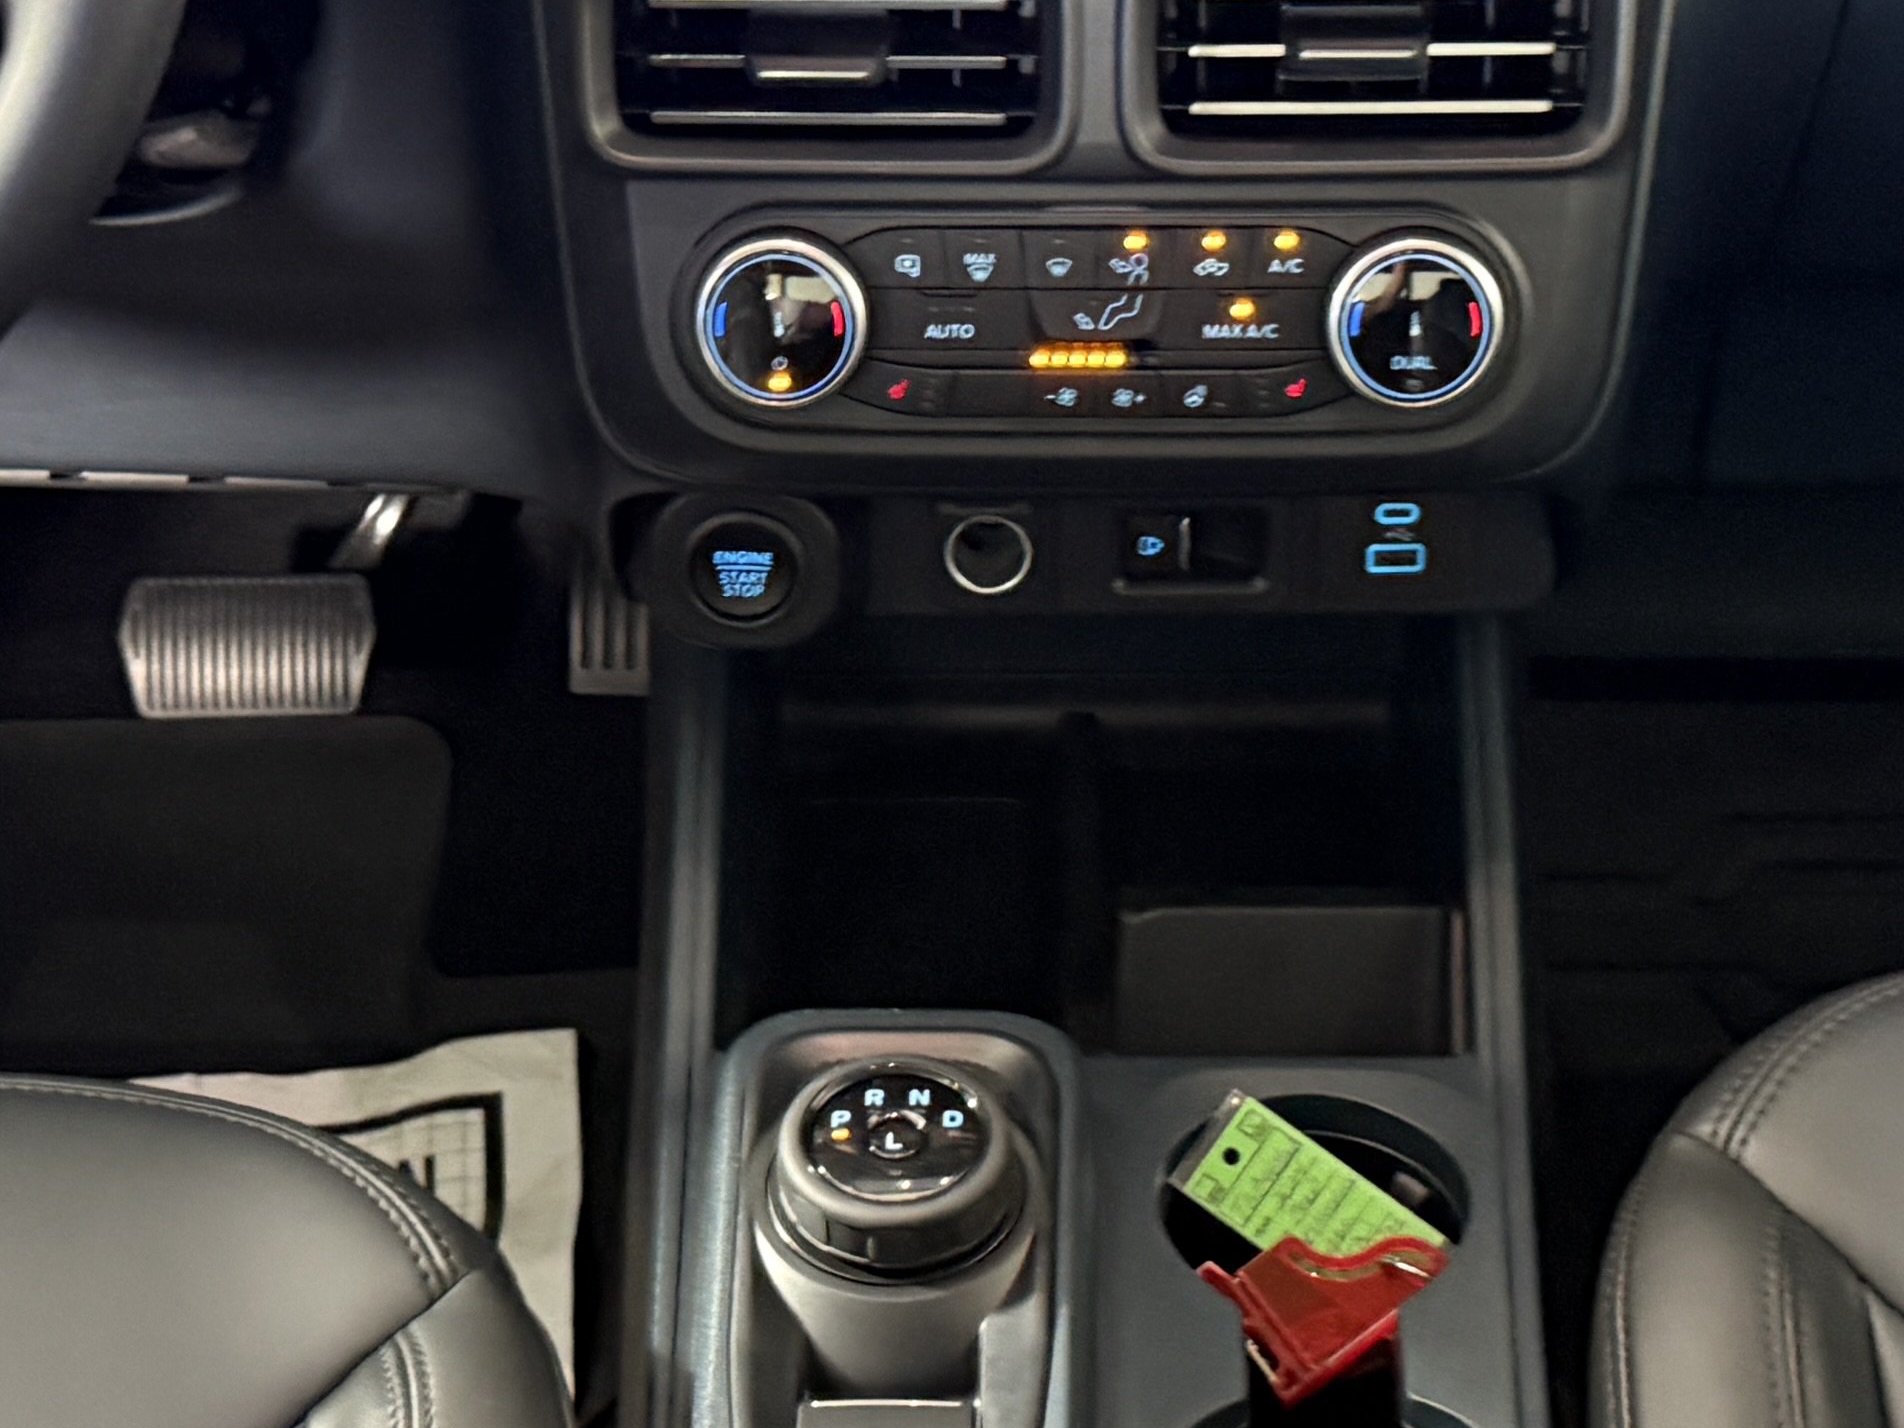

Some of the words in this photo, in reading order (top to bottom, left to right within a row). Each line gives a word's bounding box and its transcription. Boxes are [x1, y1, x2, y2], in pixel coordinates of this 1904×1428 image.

[1267, 258, 1305, 274] A/C
[924, 324, 976, 339] AUTO
[1202, 323, 1245, 339] MAX
[1246, 323, 1280, 339] A/C
[719, 572, 768, 585] START
[721, 585, 765, 598] STOP
[830, 1110, 851, 1128] P
[864, 1089, 884, 1106] R
[908, 1088, 931, 1106] N
[942, 1110, 964, 1128] D
[885, 1131, 903, 1149] L
